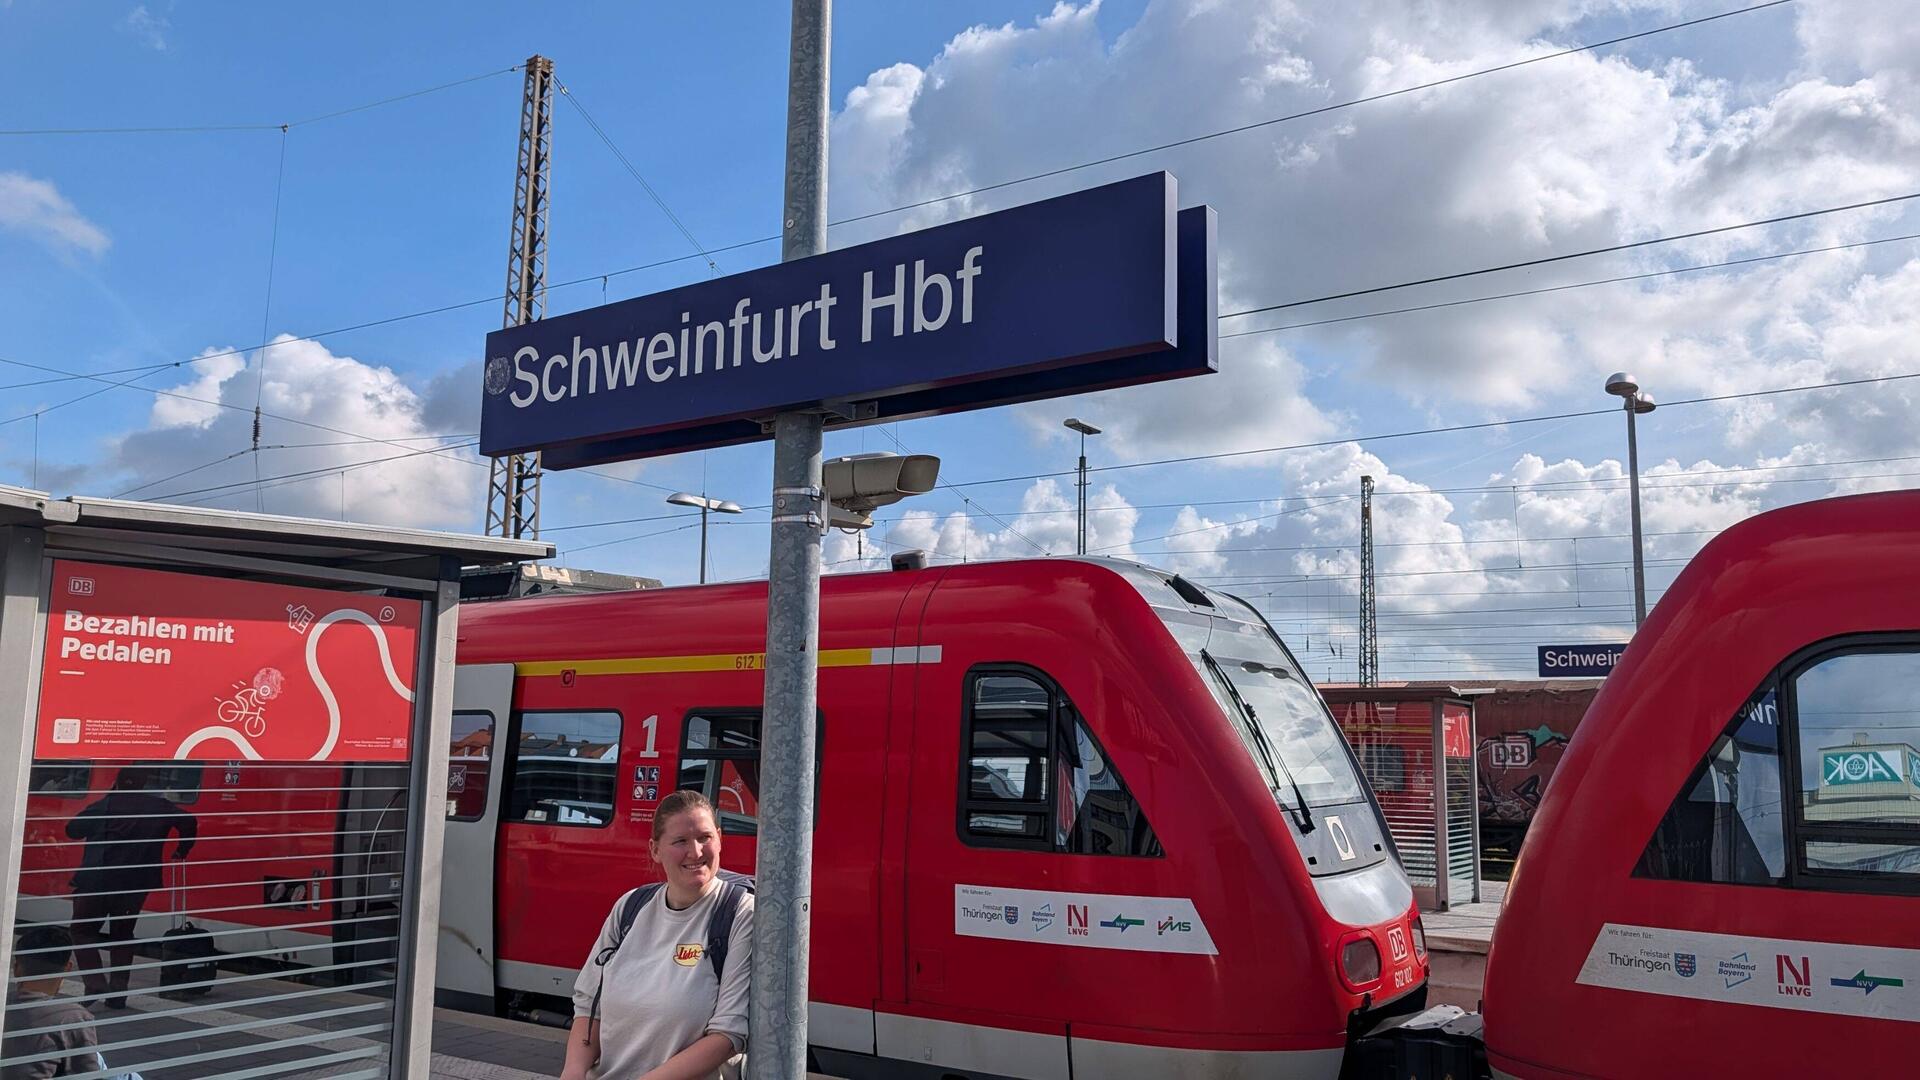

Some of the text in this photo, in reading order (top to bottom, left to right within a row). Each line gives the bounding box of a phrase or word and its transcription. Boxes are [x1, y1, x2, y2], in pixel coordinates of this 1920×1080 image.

[509, 246, 983, 408] Schweinfurt Hbf
[71, 579, 92, 593] DB
[64, 609, 235, 643] Bezahlen mit
[60, 636, 172, 664] Pedalen
[735, 655, 755, 669] 612
[639, 714, 660, 758] 1
[1493, 744, 1527, 763] DB
[962, 907, 1003, 922] Thüringen
[1067, 928, 1089, 936] LNVG
[1389, 929, 1407, 958] DB
[1640, 949, 1671, 959] Freistaat
[1608, 952, 1671, 973] Thüringen
[1719, 960, 1756, 971] Bahnland
[1718, 968, 1745, 977] Bayern
[1856, 979, 1874, 987] NVV
[1777, 985, 1812, 997] LNVG
